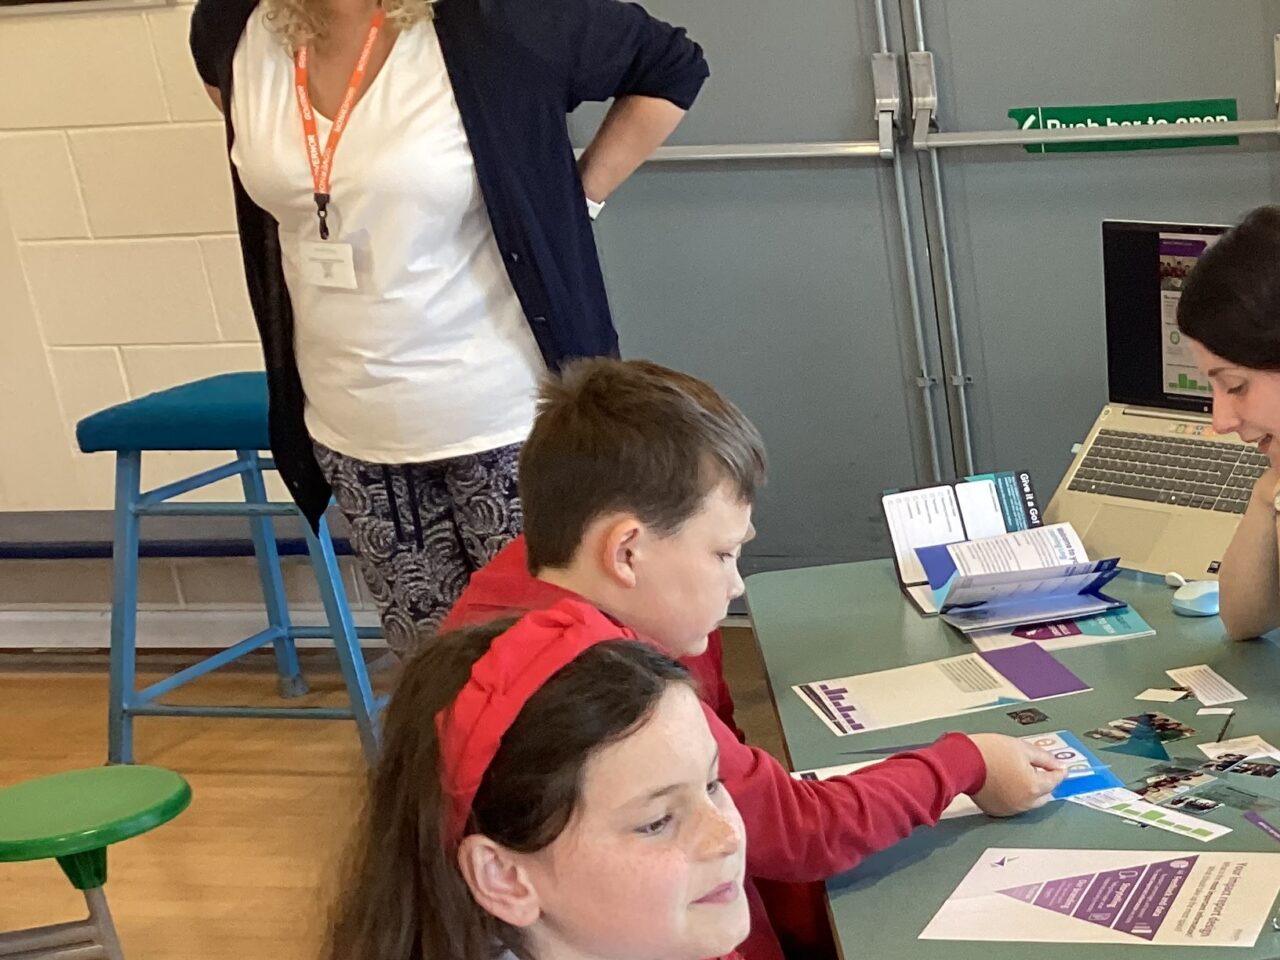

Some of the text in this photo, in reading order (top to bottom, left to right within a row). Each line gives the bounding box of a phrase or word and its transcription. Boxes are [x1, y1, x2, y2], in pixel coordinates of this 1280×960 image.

[1231, 862, 1248, 876] Your
[1220, 876, 1241, 896] impact
[1198, 916, 1220, 937] design
